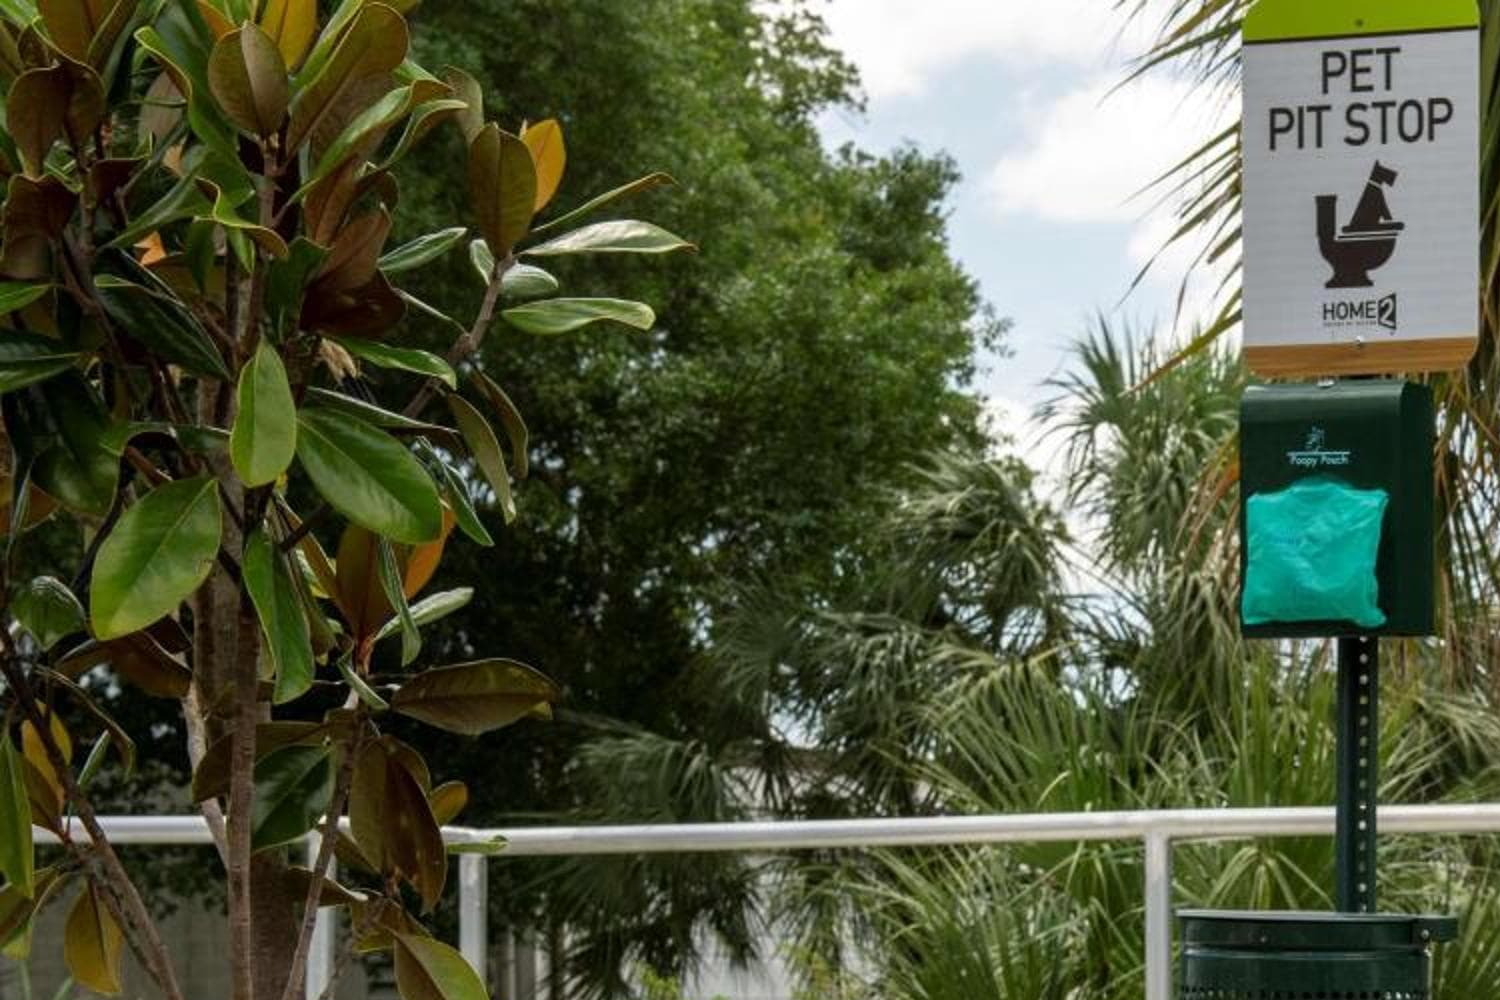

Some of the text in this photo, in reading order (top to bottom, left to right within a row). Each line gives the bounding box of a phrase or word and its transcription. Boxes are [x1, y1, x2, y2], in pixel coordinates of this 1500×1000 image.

[1322, 47, 1400, 94] PET
[1269, 98, 1453, 150] PIT STOP
